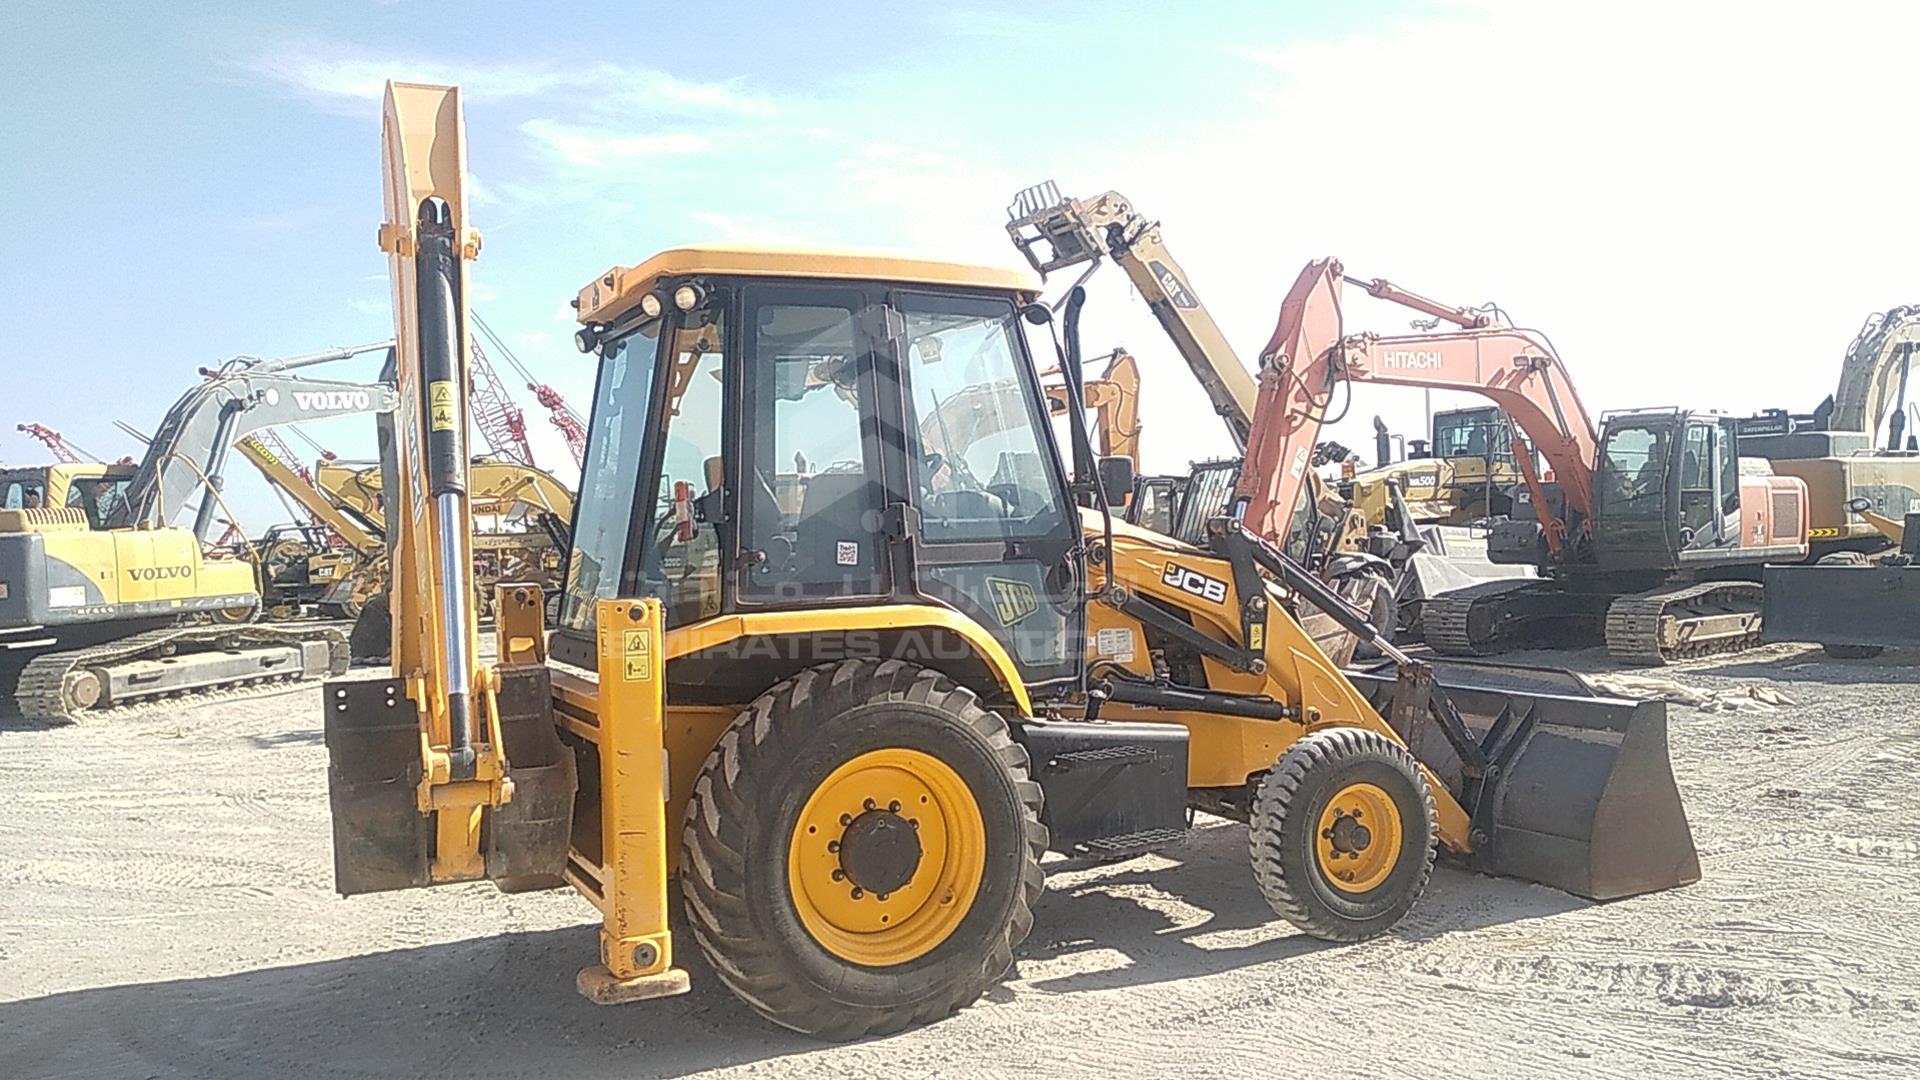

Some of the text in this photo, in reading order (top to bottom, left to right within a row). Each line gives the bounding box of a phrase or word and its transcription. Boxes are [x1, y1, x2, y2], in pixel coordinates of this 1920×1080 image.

[1161, 272, 1181, 298] CAT
[1383, 351, 1441, 369] HITACHI
[292, 391, 370, 411] VOLVO
[472, 504, 501, 514] UNDAI
[127, 565, 192, 582] VOLVO
[1163, 566, 1227, 603] JCB
[995, 581, 1037, 623] JCB
